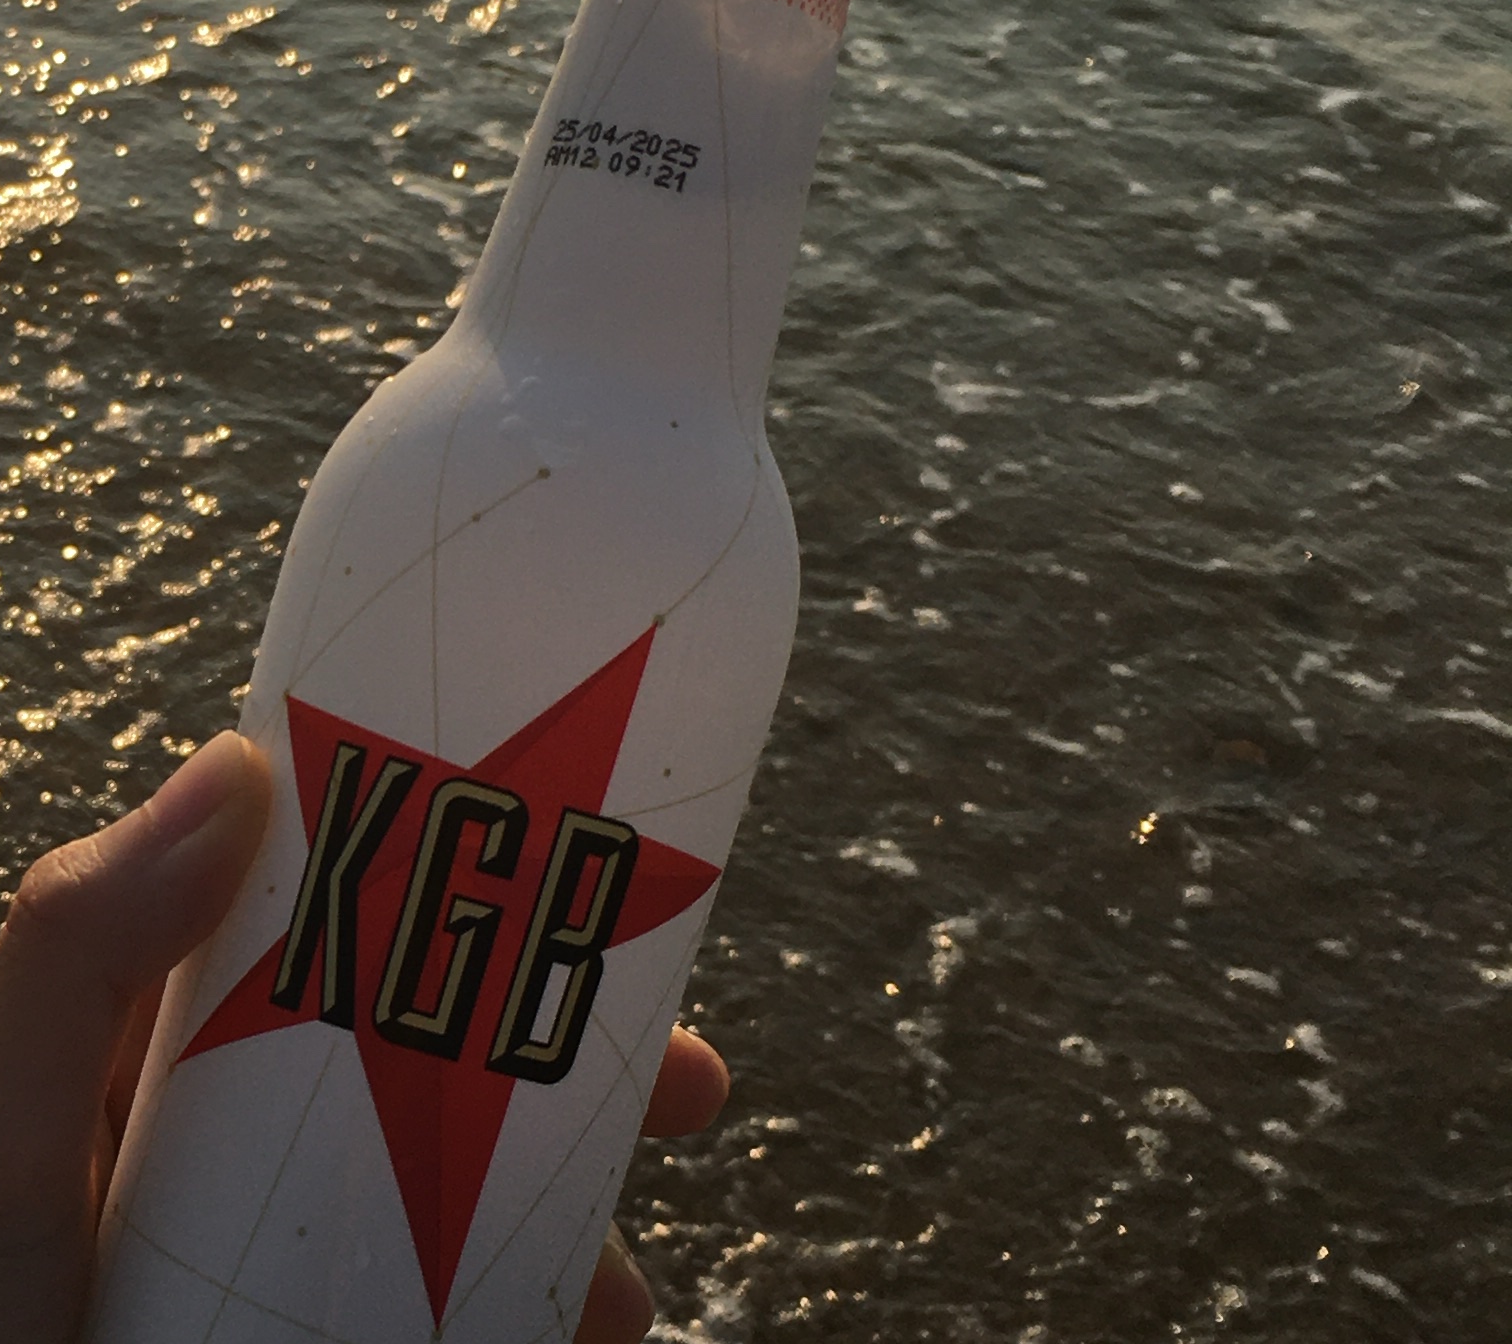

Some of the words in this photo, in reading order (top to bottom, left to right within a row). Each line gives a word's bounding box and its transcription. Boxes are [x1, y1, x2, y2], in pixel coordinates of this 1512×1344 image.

[553, 119, 701, 169] 25/04/2025
[608, 152, 687, 193] 09:21
[269, 740, 640, 1085] KGB
